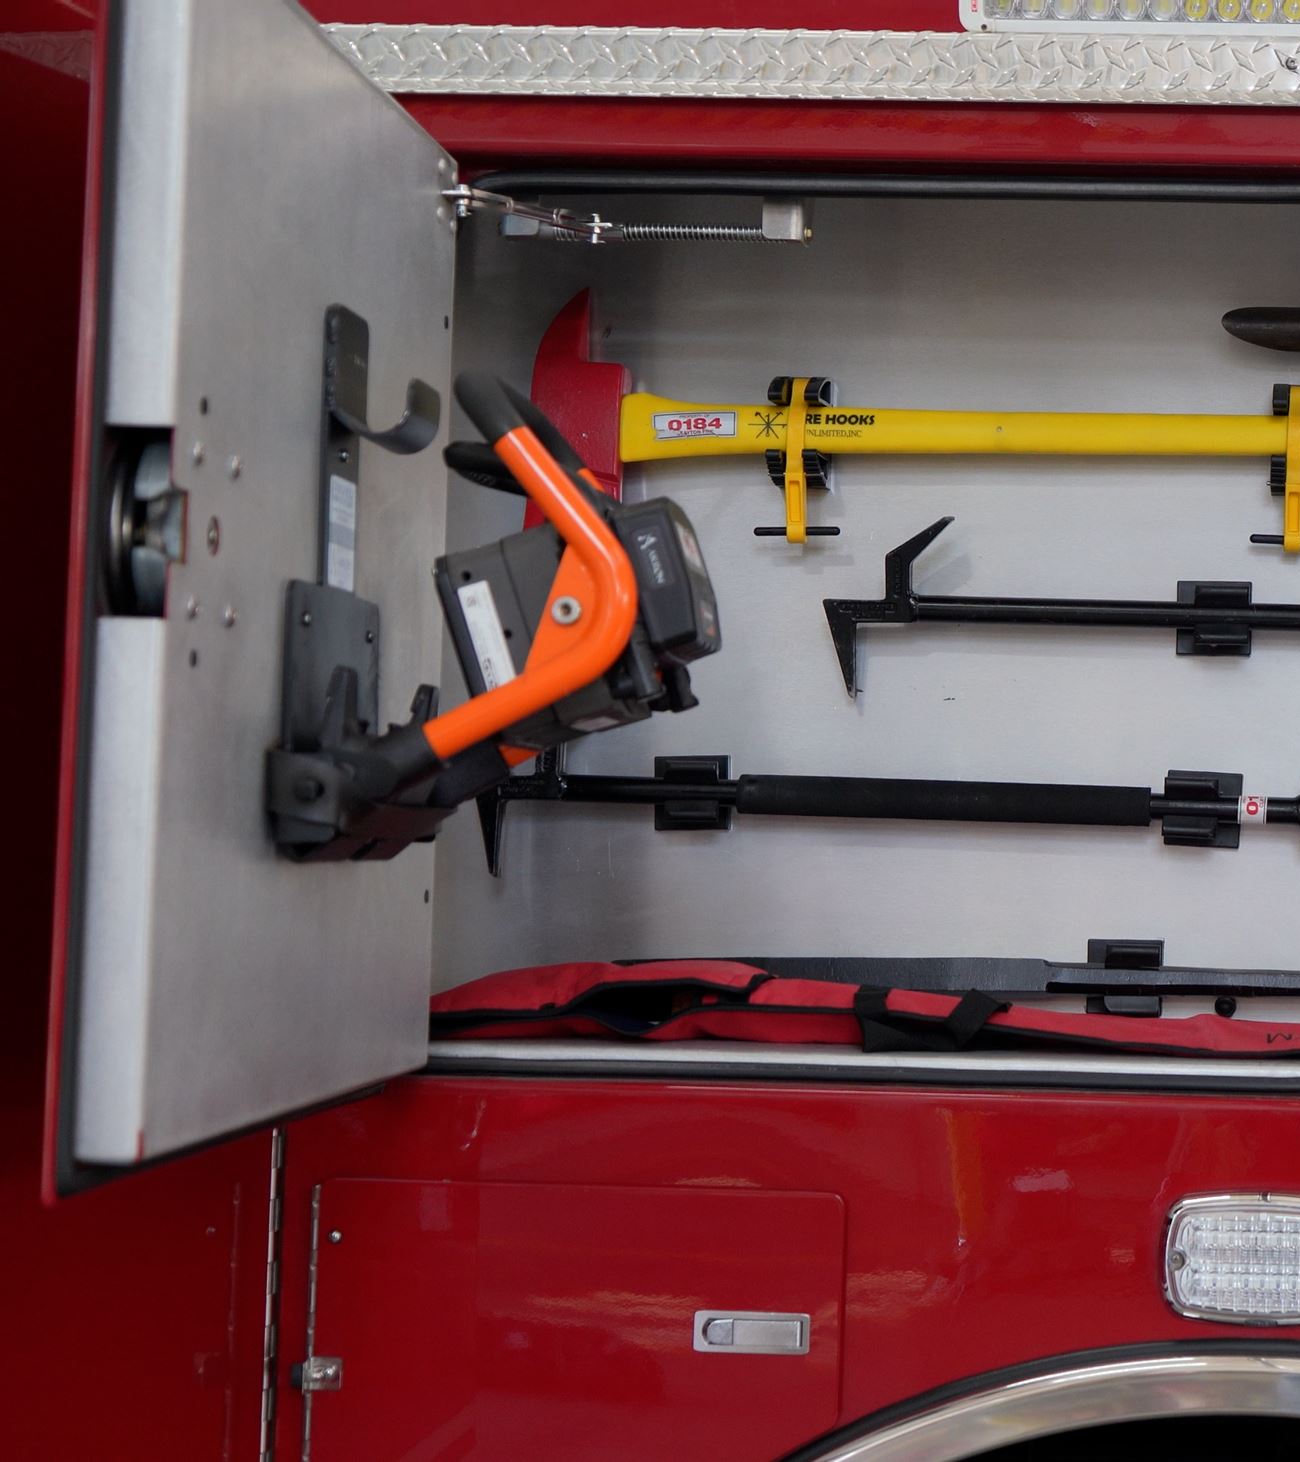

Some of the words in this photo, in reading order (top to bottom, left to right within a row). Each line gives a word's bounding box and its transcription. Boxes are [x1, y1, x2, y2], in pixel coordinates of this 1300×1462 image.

[667, 417, 722, 431] 0184
[805, 414, 821, 424] RE
[825, 414, 875, 425] HOOKS
